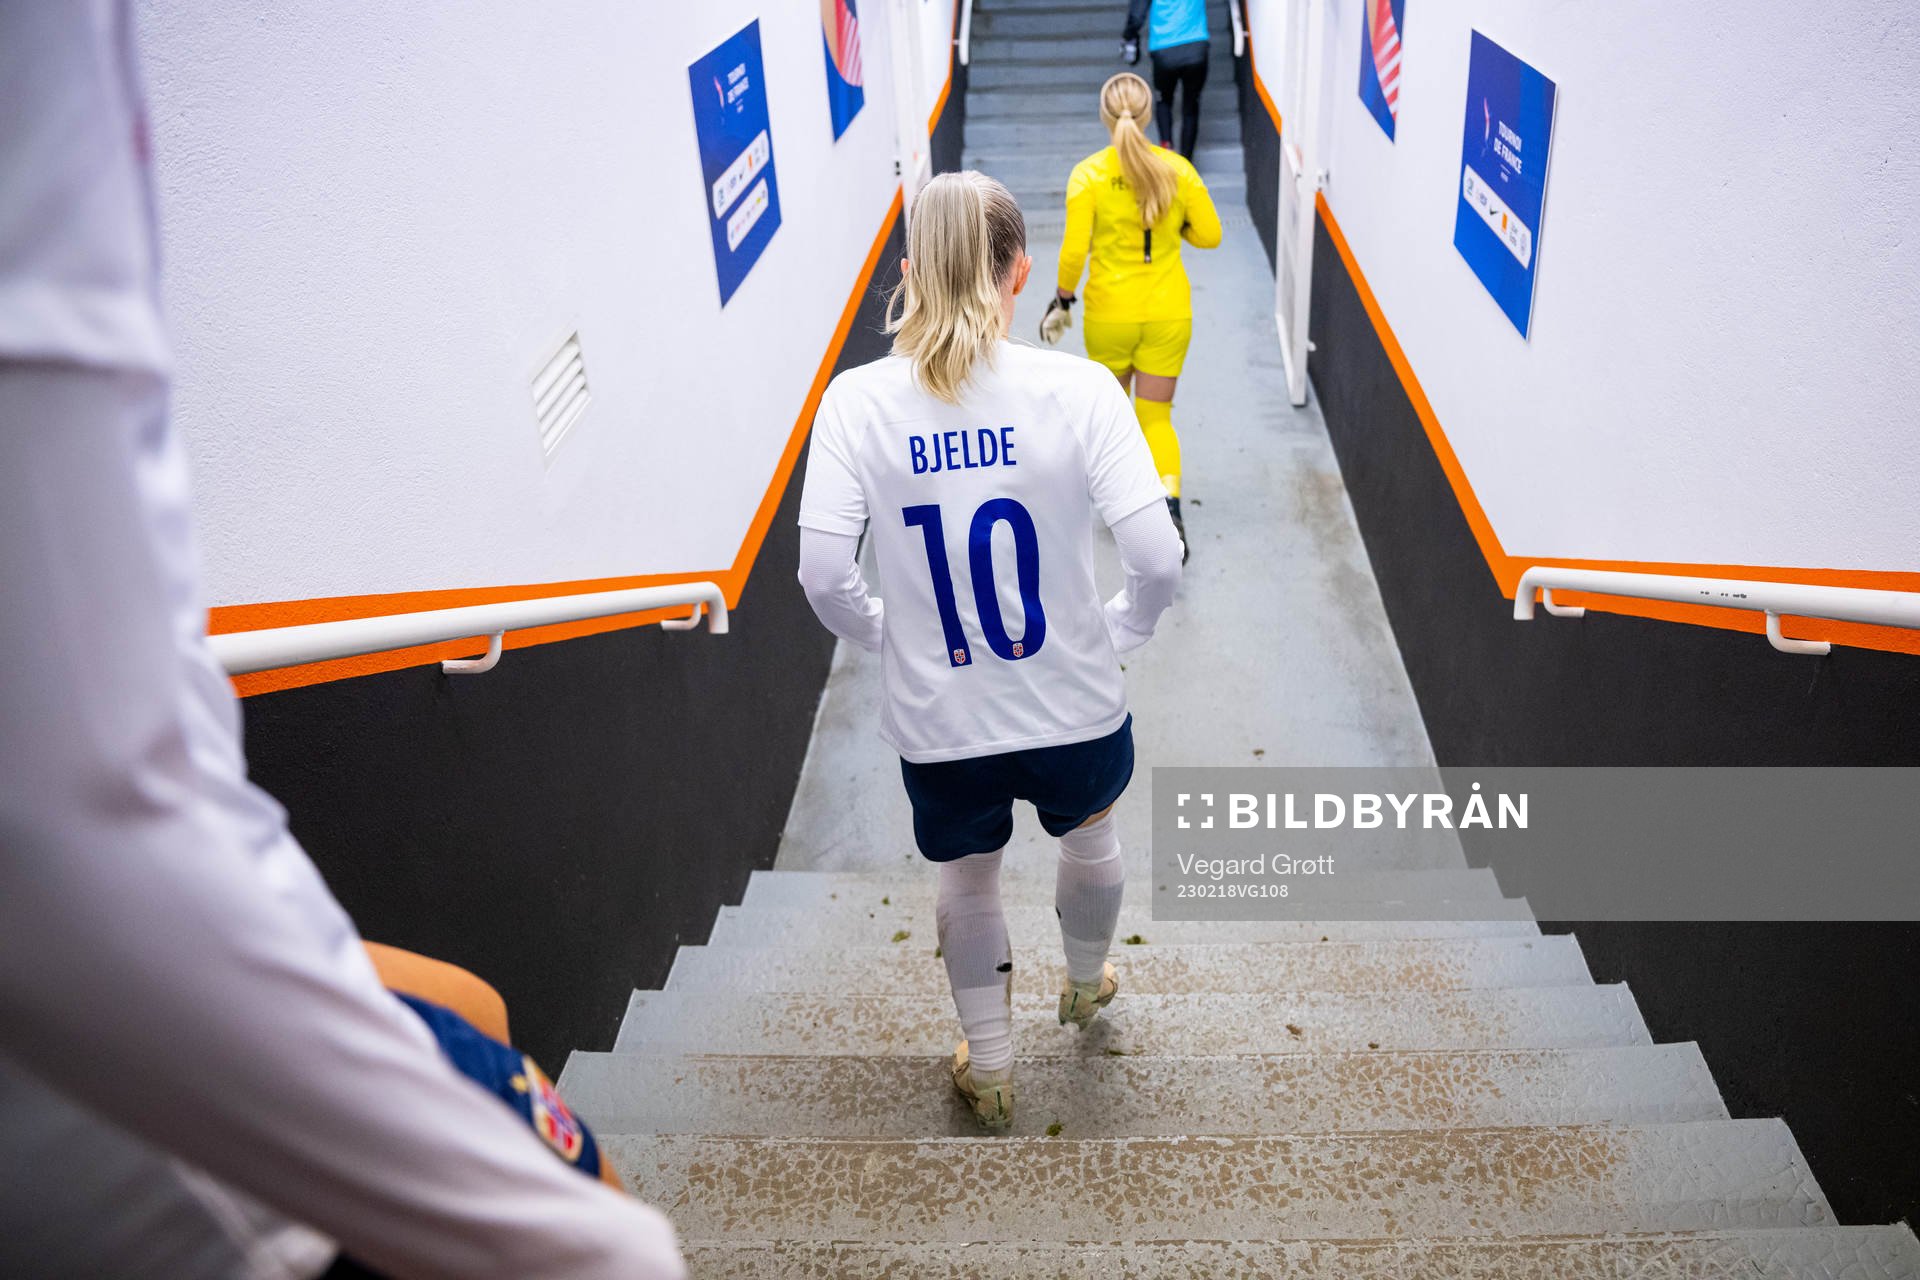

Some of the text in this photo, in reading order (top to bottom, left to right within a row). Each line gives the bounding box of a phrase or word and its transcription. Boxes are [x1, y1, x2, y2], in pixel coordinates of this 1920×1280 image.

[1501, 143, 1522, 174] FRANCE
[909, 426, 1017, 475] BJELDE
[902, 497, 1047, 668] 10
